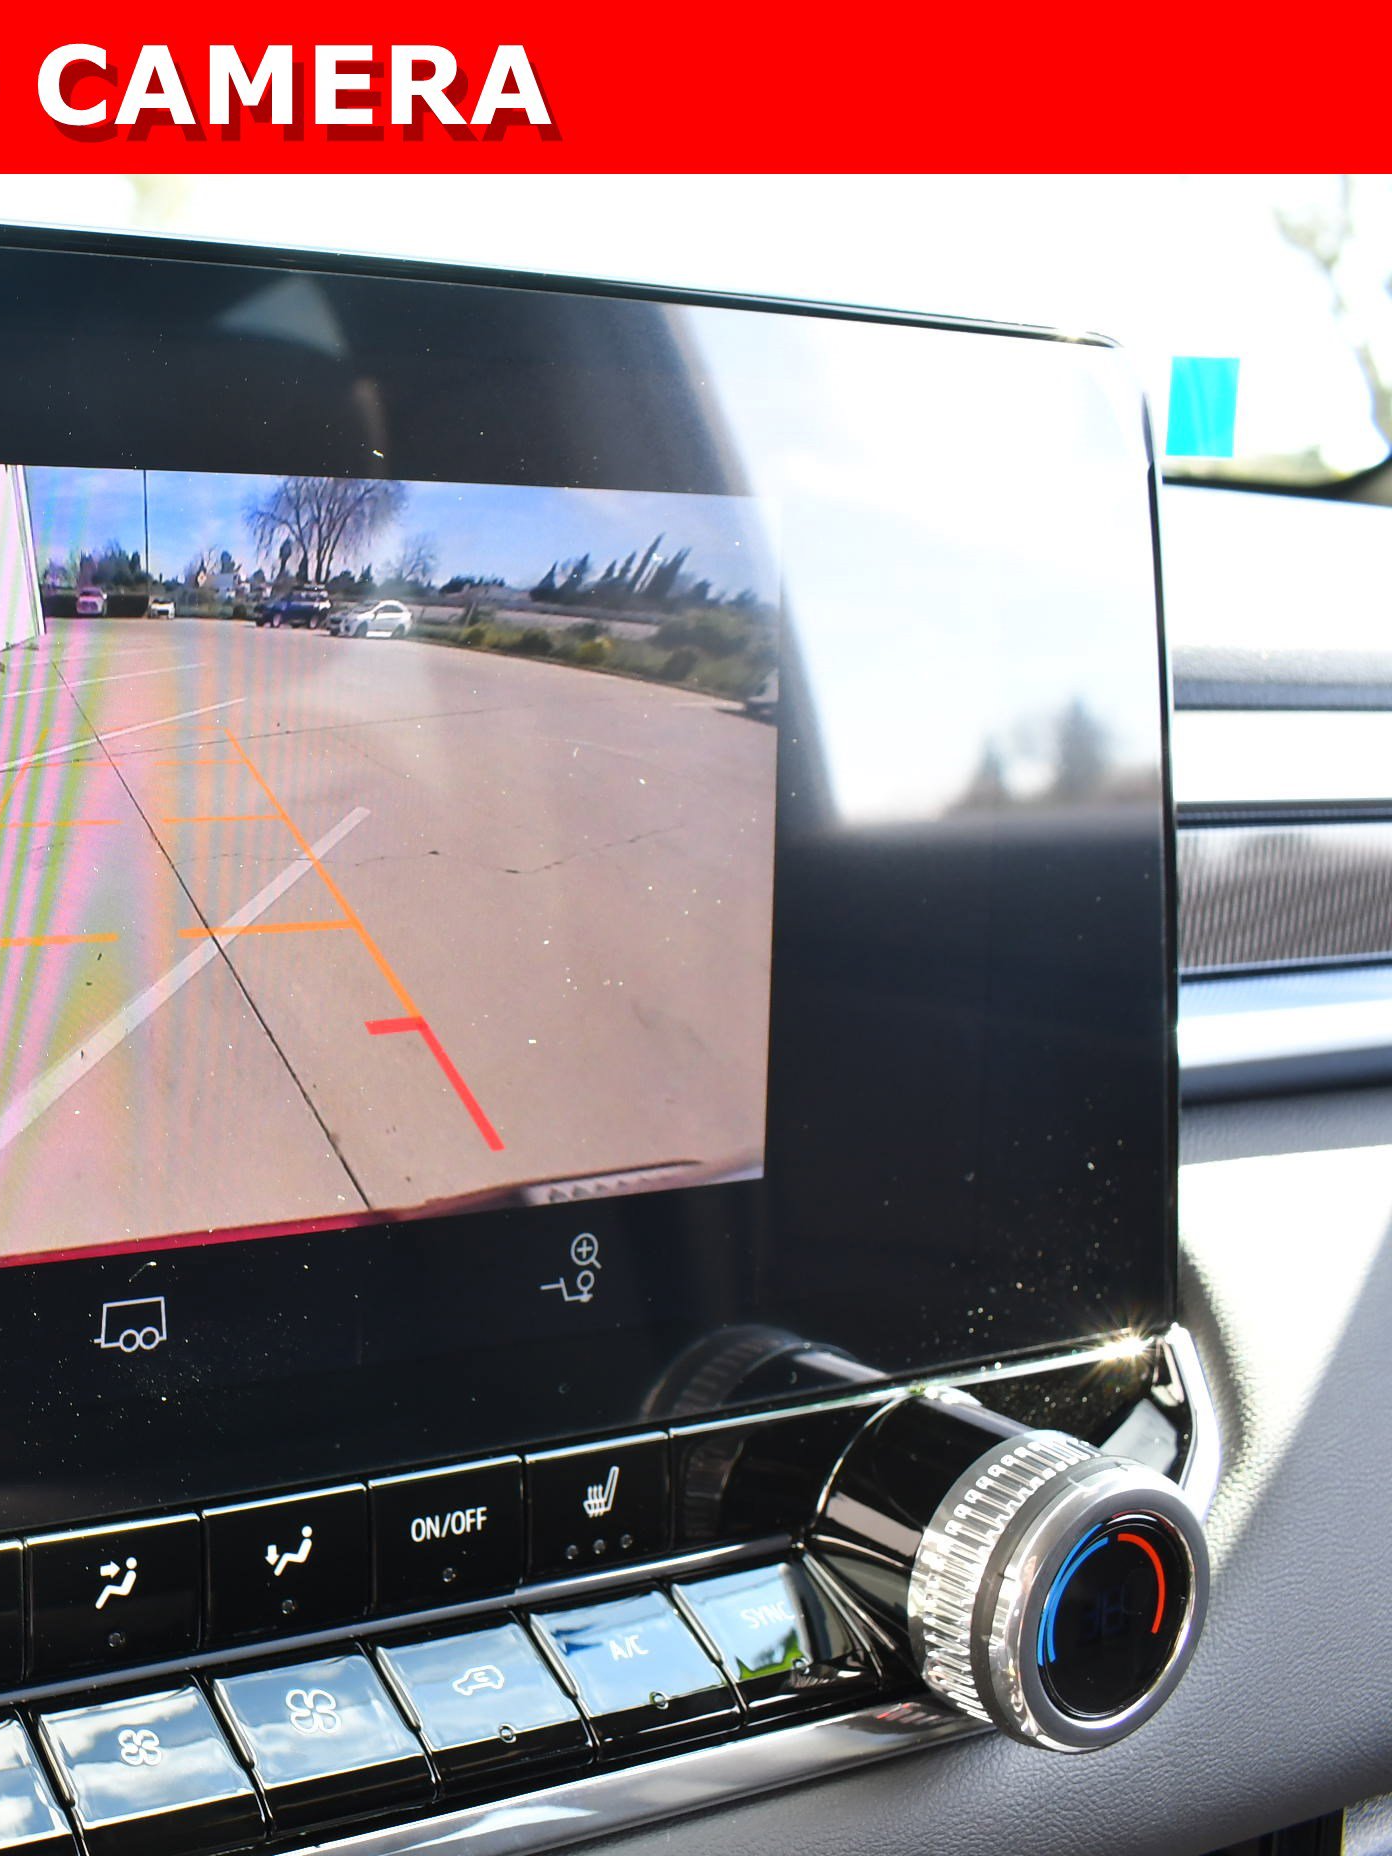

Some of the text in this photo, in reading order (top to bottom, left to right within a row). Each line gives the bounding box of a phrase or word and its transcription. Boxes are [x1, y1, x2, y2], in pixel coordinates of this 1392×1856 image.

[411, 1506, 488, 1542] ON/OFF
[740, 1600, 796, 1629] SYNC
[609, 1634, 649, 1661] A/C
